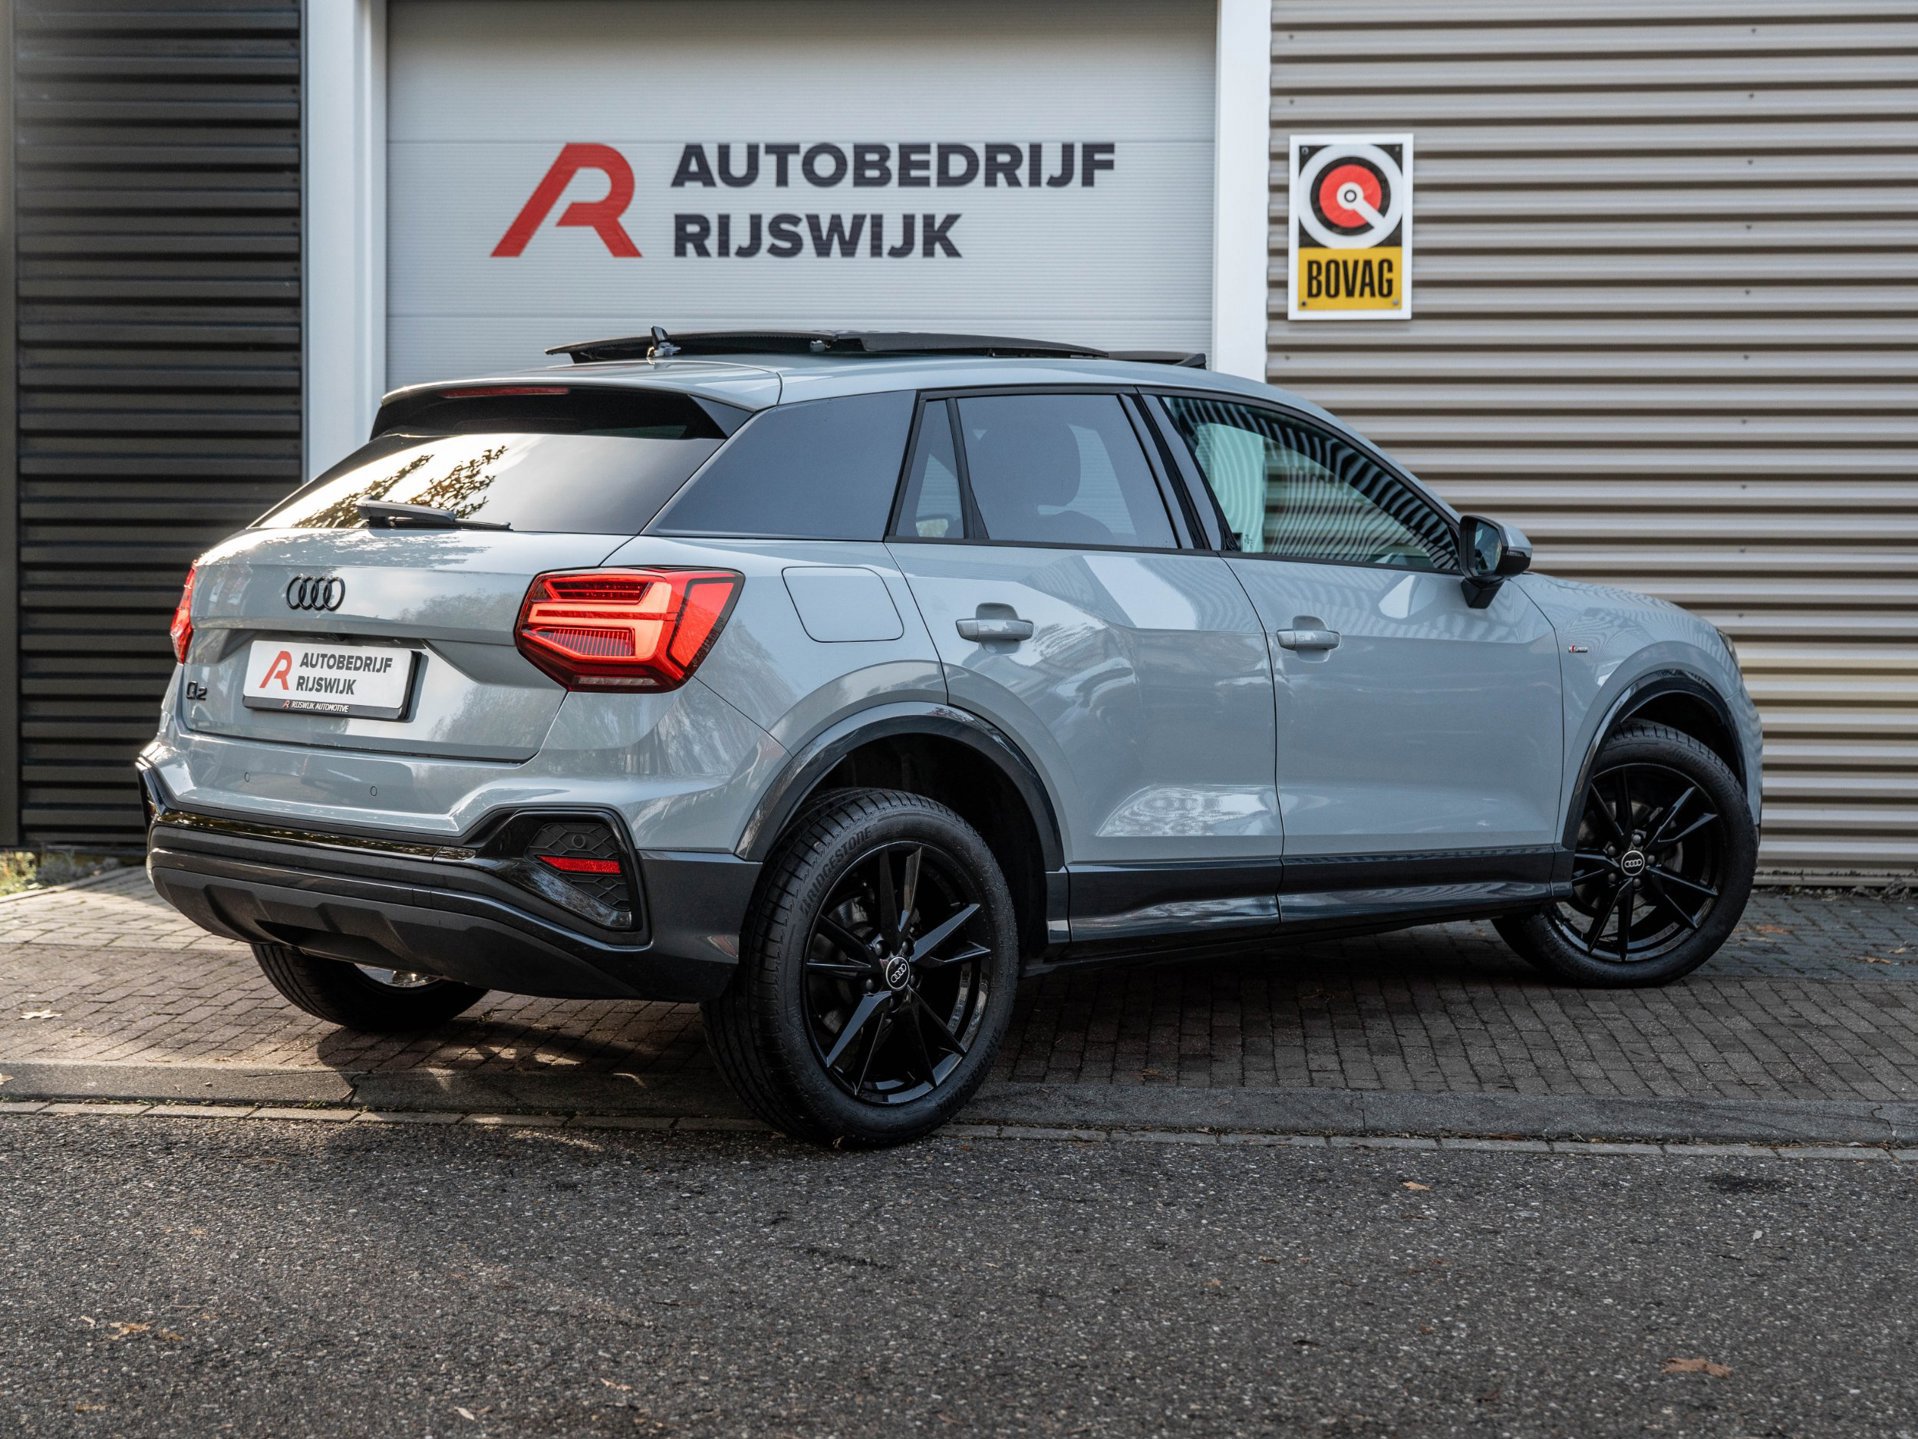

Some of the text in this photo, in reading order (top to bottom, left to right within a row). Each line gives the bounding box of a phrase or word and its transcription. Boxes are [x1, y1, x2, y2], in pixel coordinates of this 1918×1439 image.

[670, 142, 1116, 188] AUTOBEDRIJF
[673, 213, 963, 258] RIJSWIJK
[1306, 258, 1394, 299] BOVAG
[299, 652, 393, 674] AUTOBEDRIJF
[186, 681, 208, 701] Q2
[296, 676, 357, 695] RIJSWIJK
[291, 701, 314, 710] RIJSWIJK
[314, 703, 349, 713] AUTOMOTIVE
